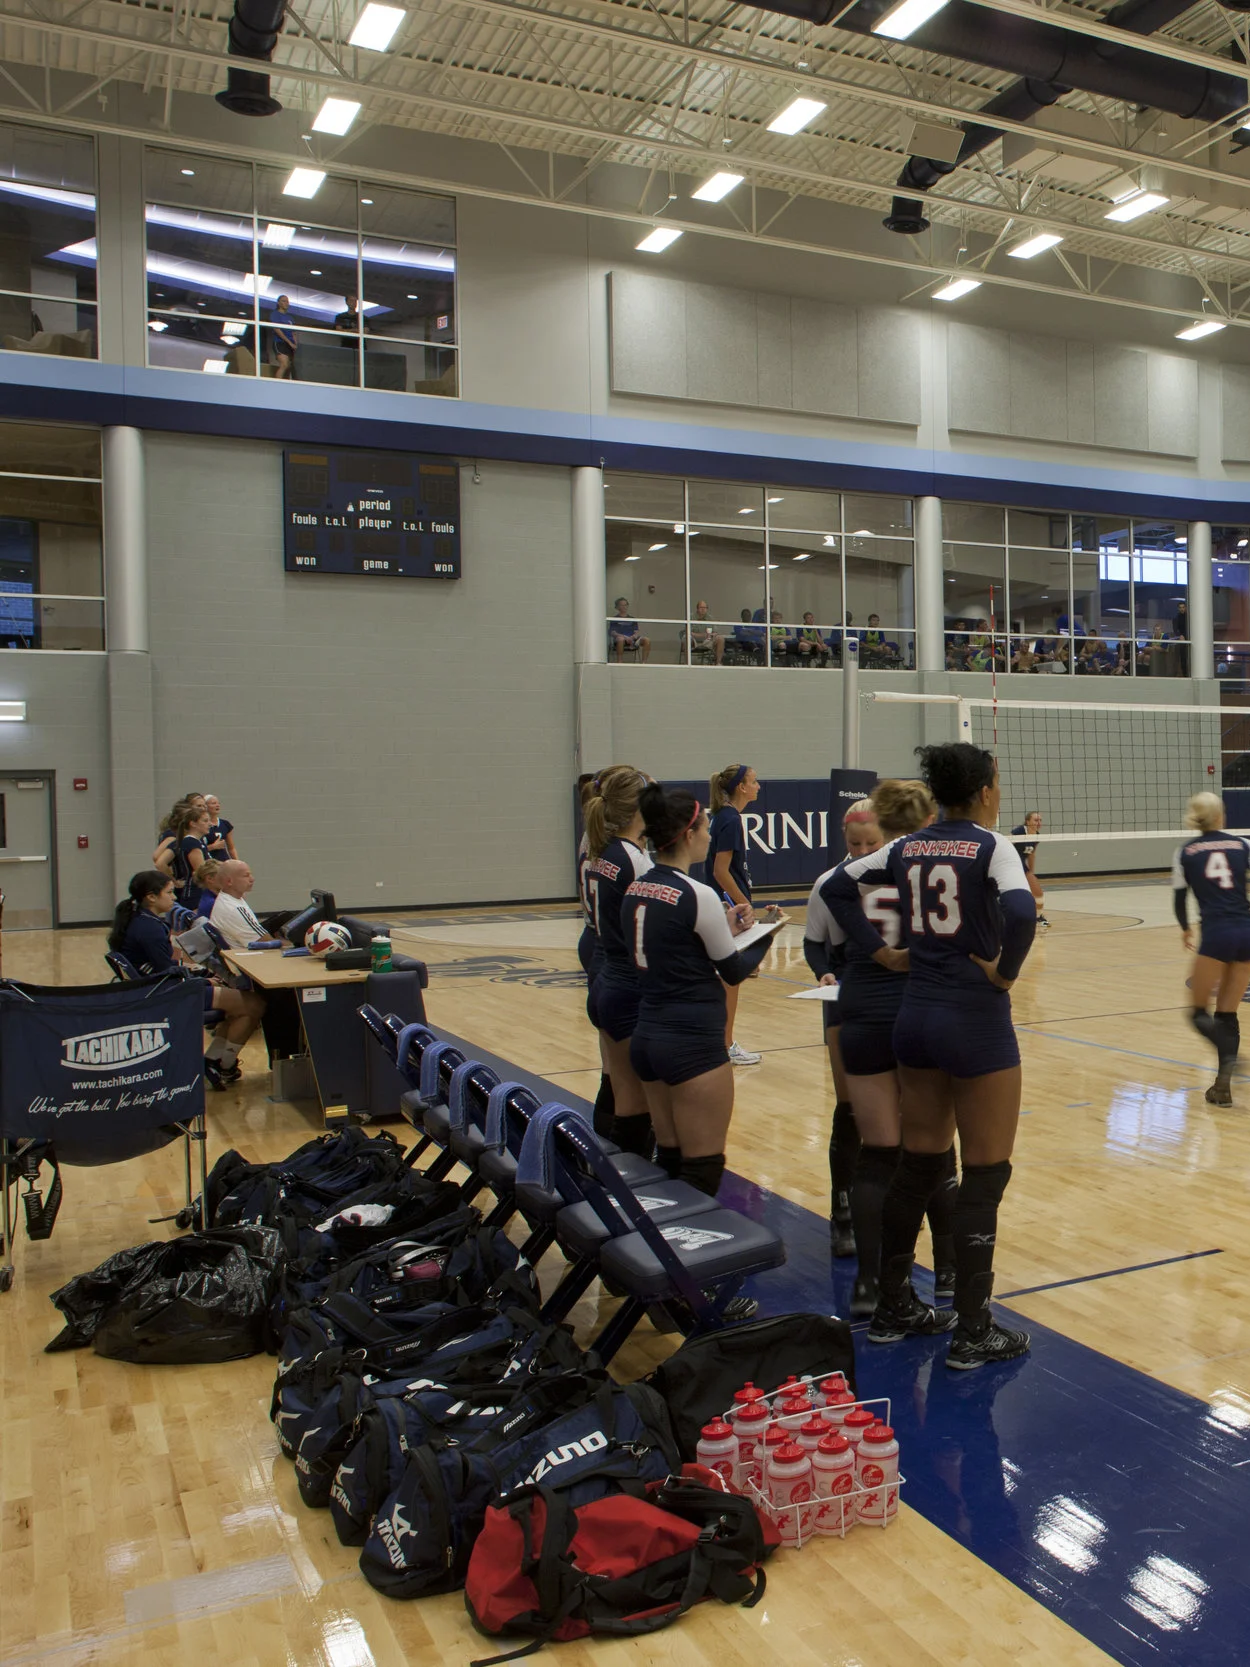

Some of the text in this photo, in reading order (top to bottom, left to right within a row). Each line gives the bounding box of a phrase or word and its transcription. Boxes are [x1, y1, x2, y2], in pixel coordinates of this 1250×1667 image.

[359, 500, 391, 511] period
[292, 512, 317, 526] fouls
[358, 517, 392, 530] player
[431, 522, 454, 534] fouls
[295, 556, 454, 573] won game won
[704, 808, 829, 855] RINI
[902, 840, 981, 859] KANKAKEE
[1204, 850, 1234, 889] 4
[625, 880, 683, 906] ANKAKEE
[907, 862, 963, 938] 13
[633, 902, 648, 970] 1
[62, 1024, 168, 1066] TACHIKARA
[72, 1069, 163, 1090] www.tachikara.com
[74, 1100, 90, 1113] the
[115, 1092, 131, 1112] You
[133, 1093, 154, 1108] bring
[153, 1087, 169, 1101] the
[500, 1430, 608, 1497] ZUNO
